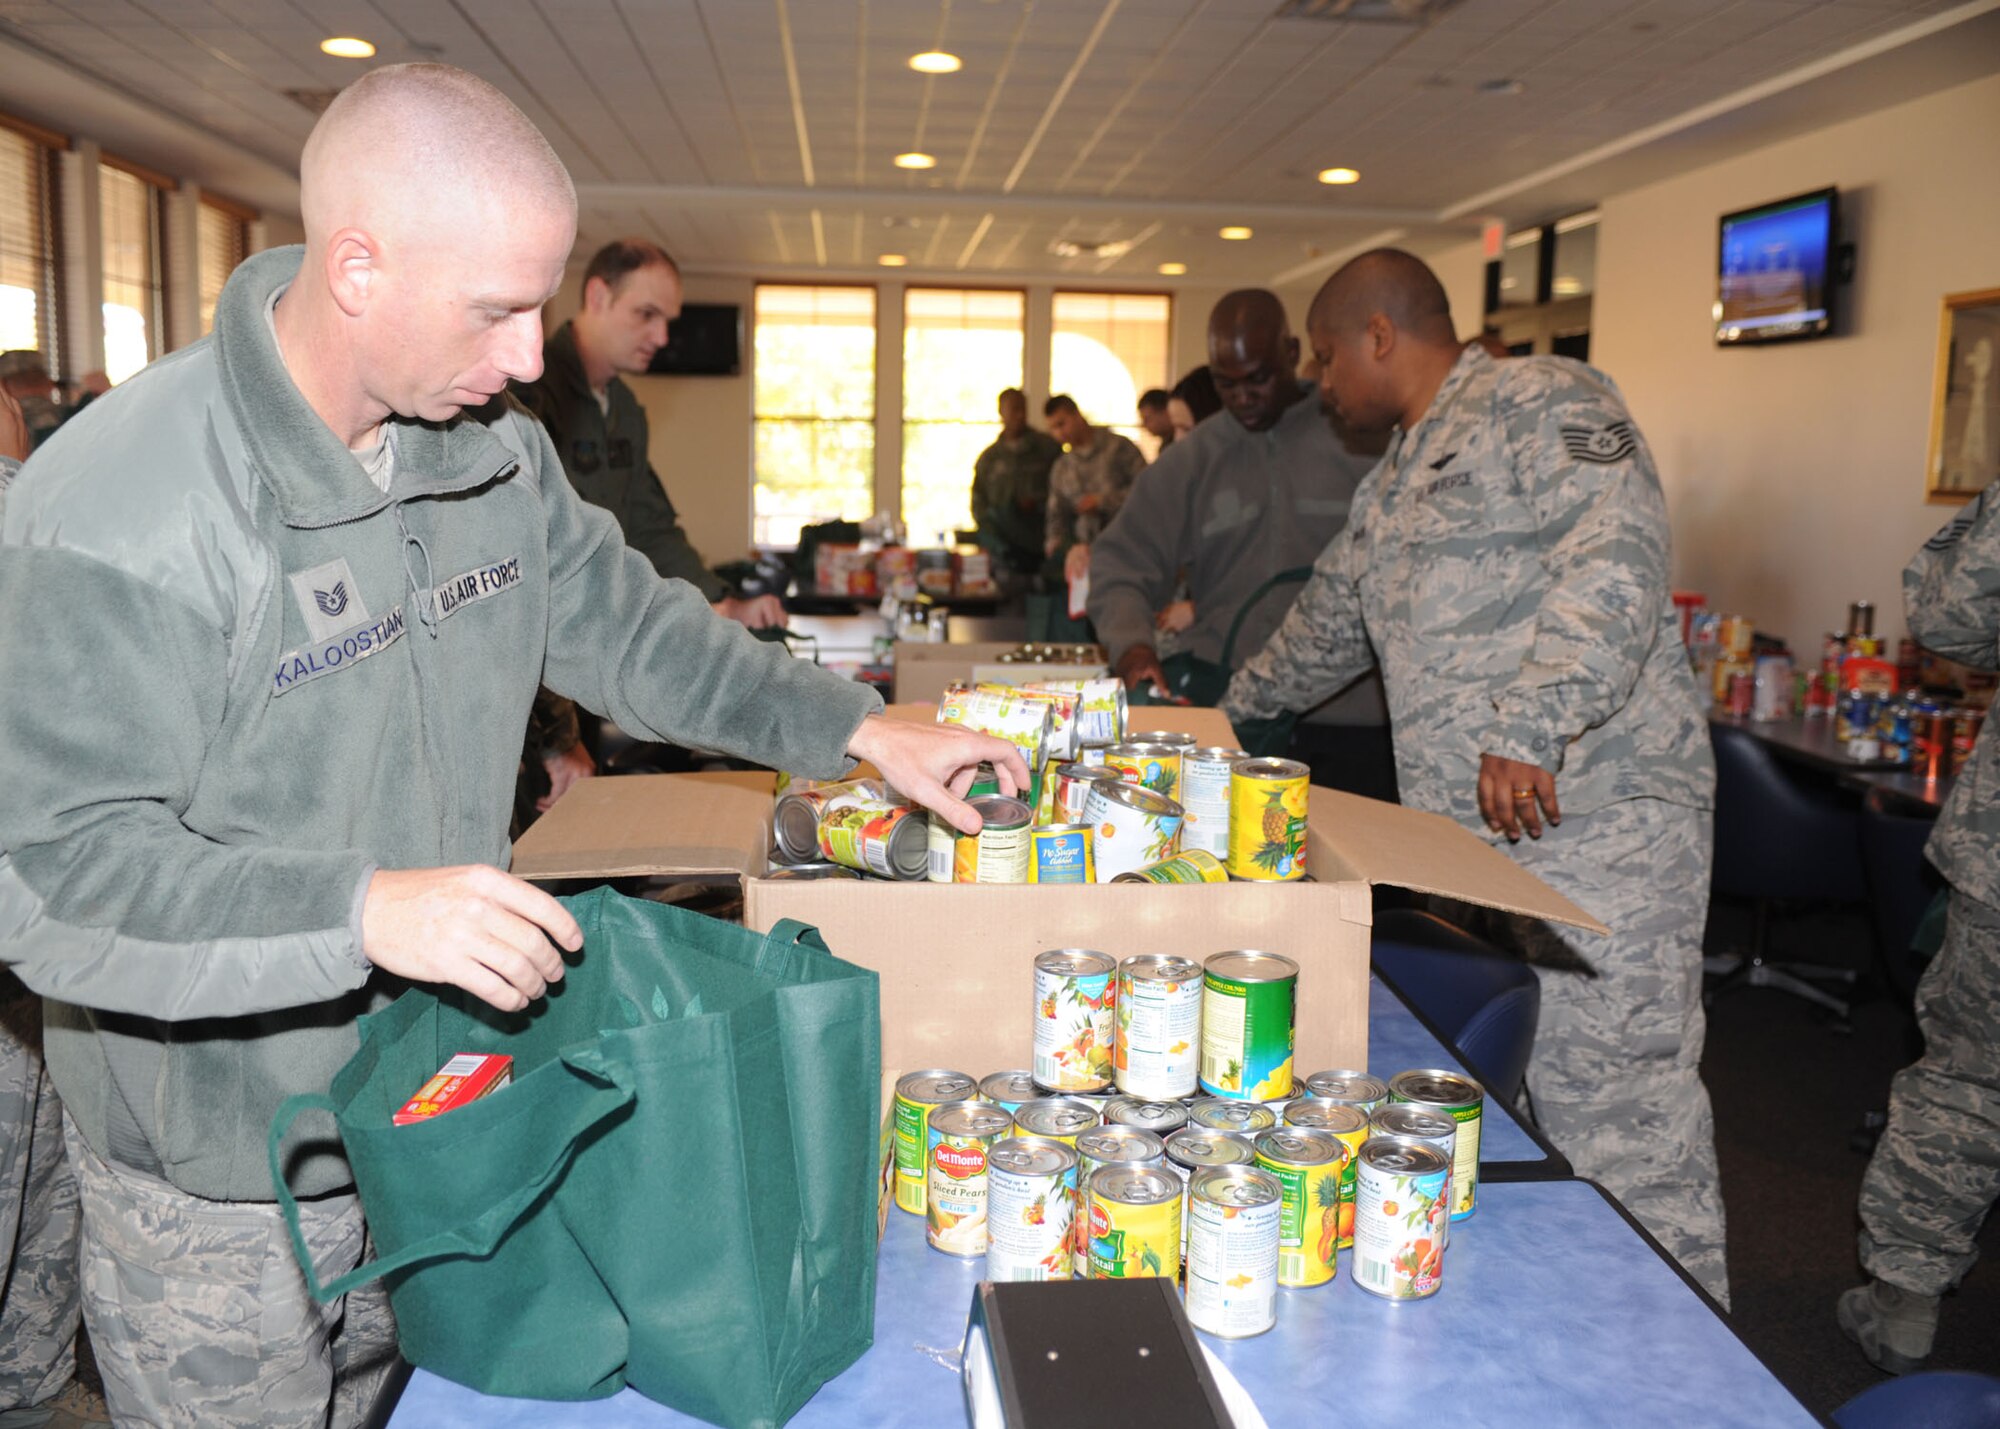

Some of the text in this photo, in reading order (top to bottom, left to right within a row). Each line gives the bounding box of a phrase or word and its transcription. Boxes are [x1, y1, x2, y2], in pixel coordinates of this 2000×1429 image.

[457, 574, 478, 605] AIR
[480, 558, 520, 592] FORCE
[274, 609, 404, 688] KALOOSTIAN
[933, 1181, 986, 1198] Sliced Pears
